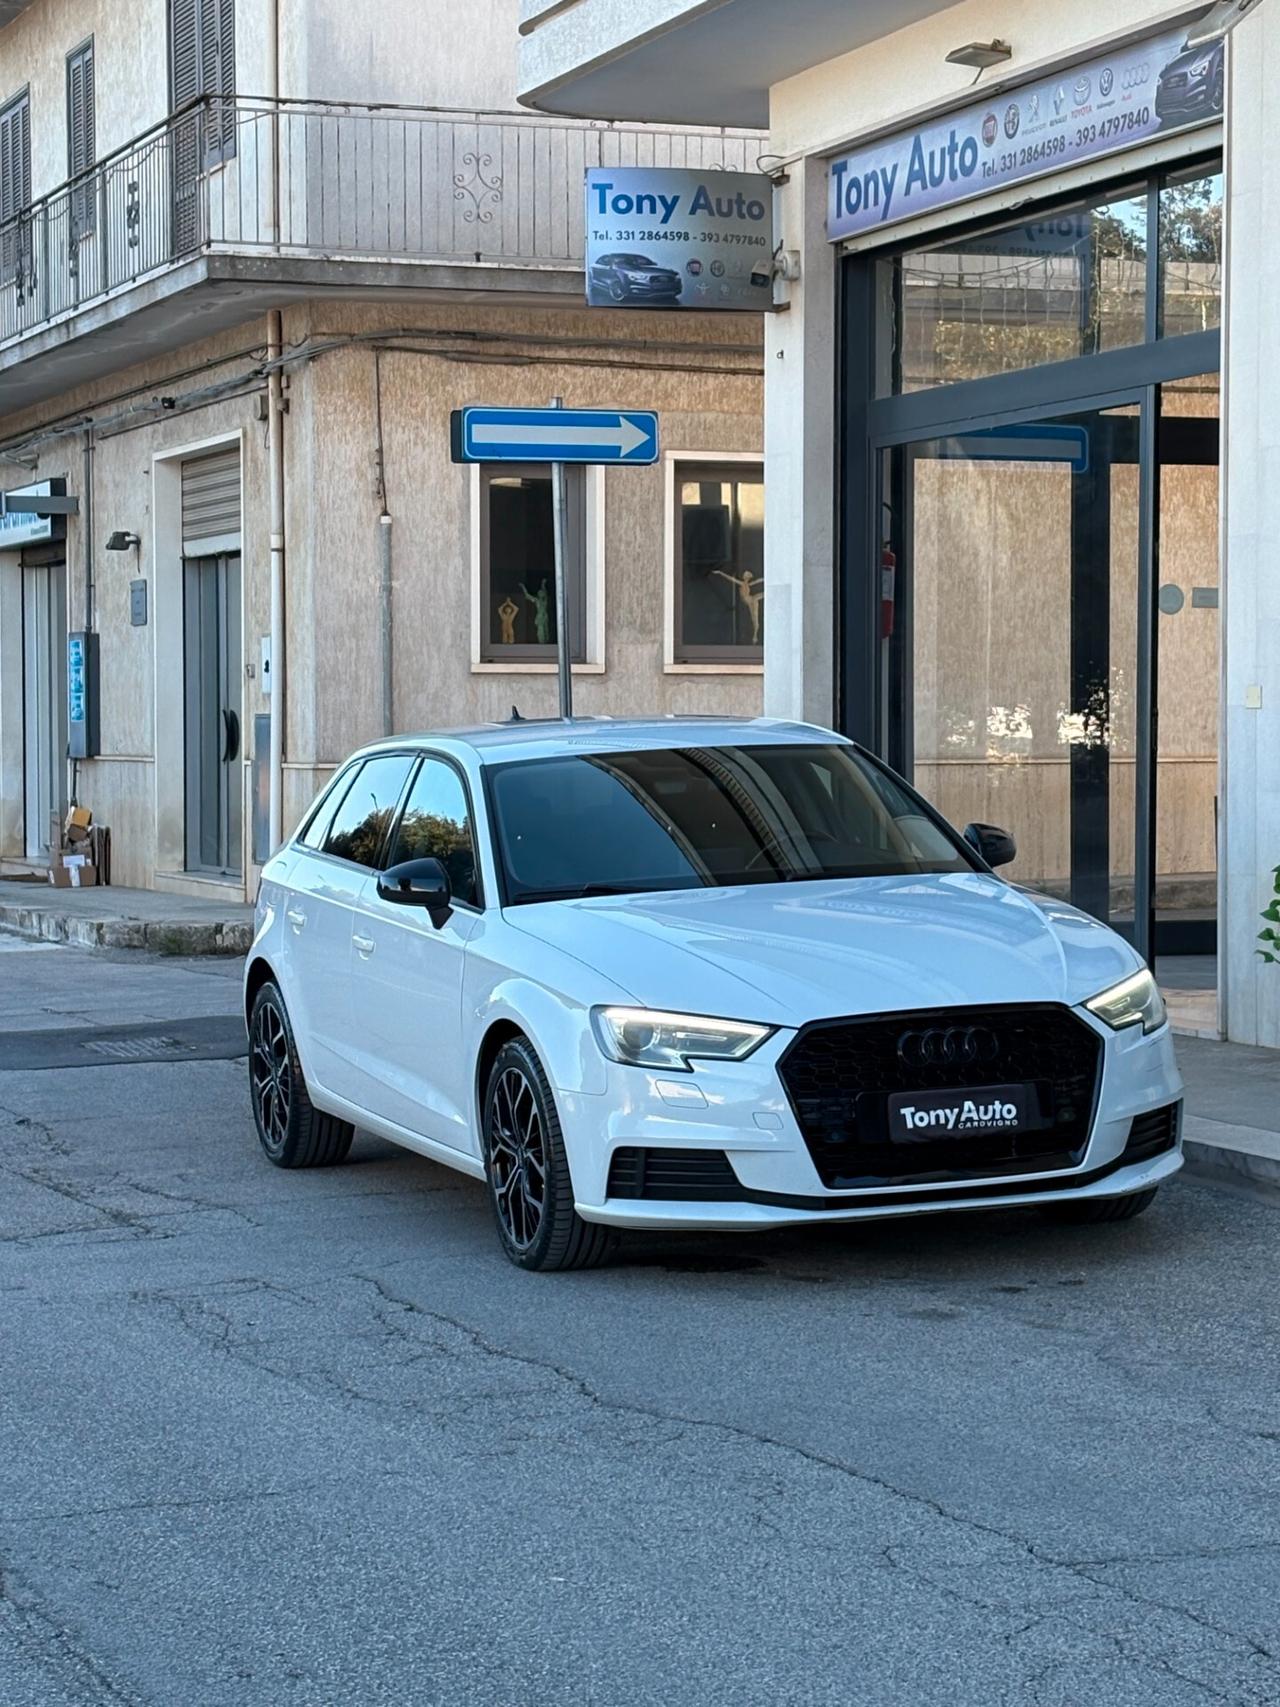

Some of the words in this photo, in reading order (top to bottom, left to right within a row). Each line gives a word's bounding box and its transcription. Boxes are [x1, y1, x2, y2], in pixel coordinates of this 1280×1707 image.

[1071, 105, 1092, 119] TOYOTA
[981, 158, 998, 178] Tel.
[1000, 153, 1017, 172] 331
[1019, 135, 1066, 167] 2864598
[1075, 124, 1096, 148] 393
[1098, 106, 1150, 139] 4797840
[832, 159, 899, 221] Tony
[904, 129, 978, 197] Auto
[592, 183, 680, 224] Tony
[688, 184, 766, 221] Auto
[592, 230, 613, 241] Tel.
[616, 230, 635, 241] 331
[639, 230, 690, 242] 2864598
[700, 232, 720, 243] 393
[722, 233, 766, 247] 4797840
[958, 1119, 1019, 1129] CAROVIGNO
